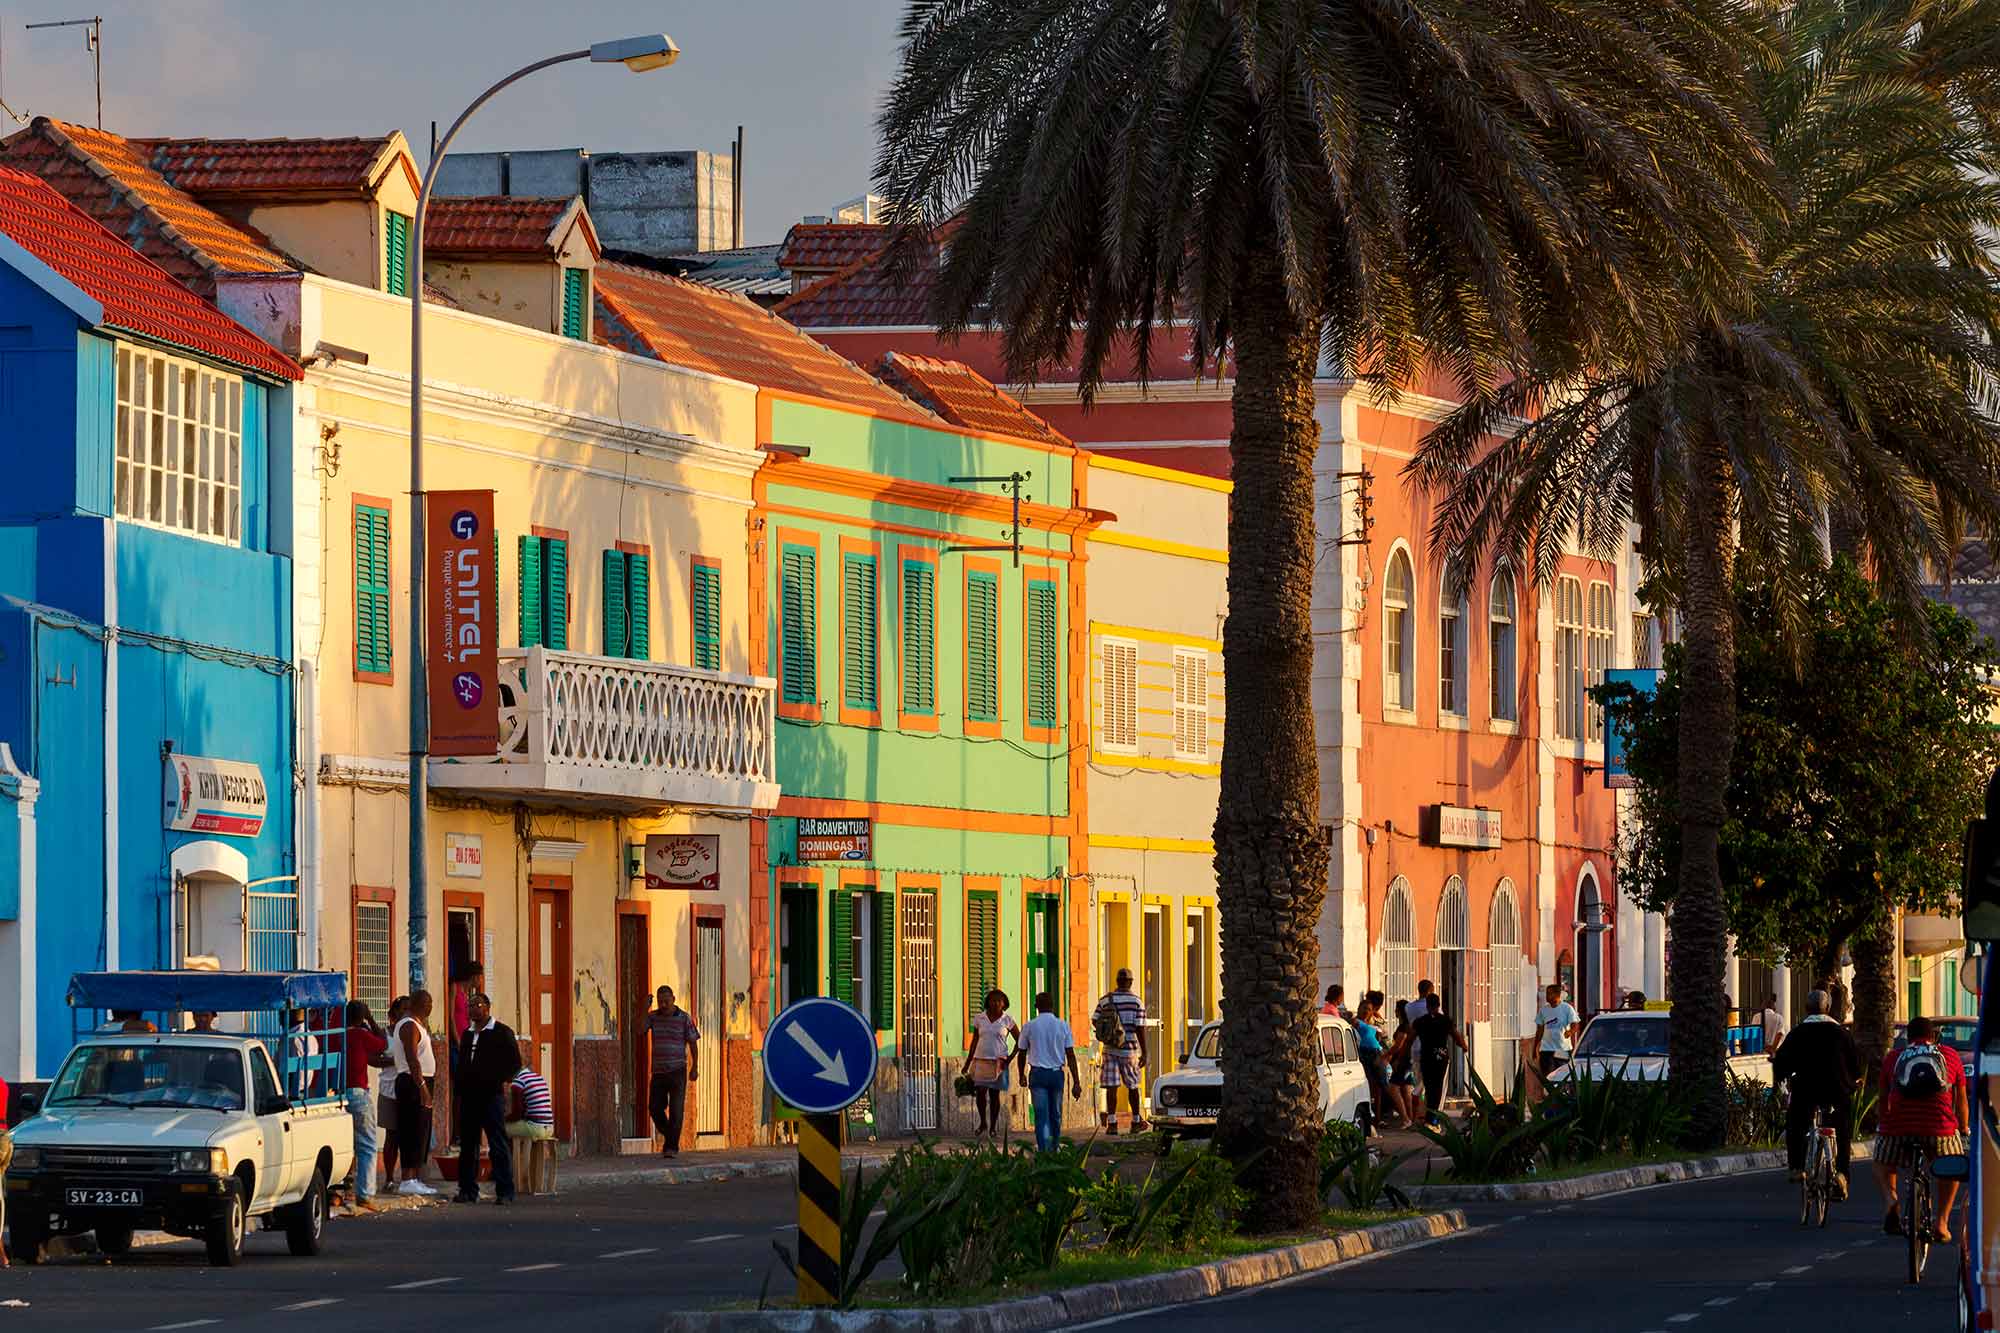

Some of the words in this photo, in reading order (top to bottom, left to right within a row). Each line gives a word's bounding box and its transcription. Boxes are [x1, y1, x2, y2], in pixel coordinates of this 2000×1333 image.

[443, 550, 454, 585] Porque
[444, 587, 455, 610] você
[458, 548, 481, 663] UNITEL
[444, 614, 454, 649] merece
[799, 819, 816, 835] BAR
[816, 820, 869, 836] BOAVENTURA
[1441, 815, 1455, 836] LOJA
[1456, 816, 1468, 838] DAS
[799, 840, 854, 852] DOMINGAS
[87, 1155, 128, 1165] TOYOTA
